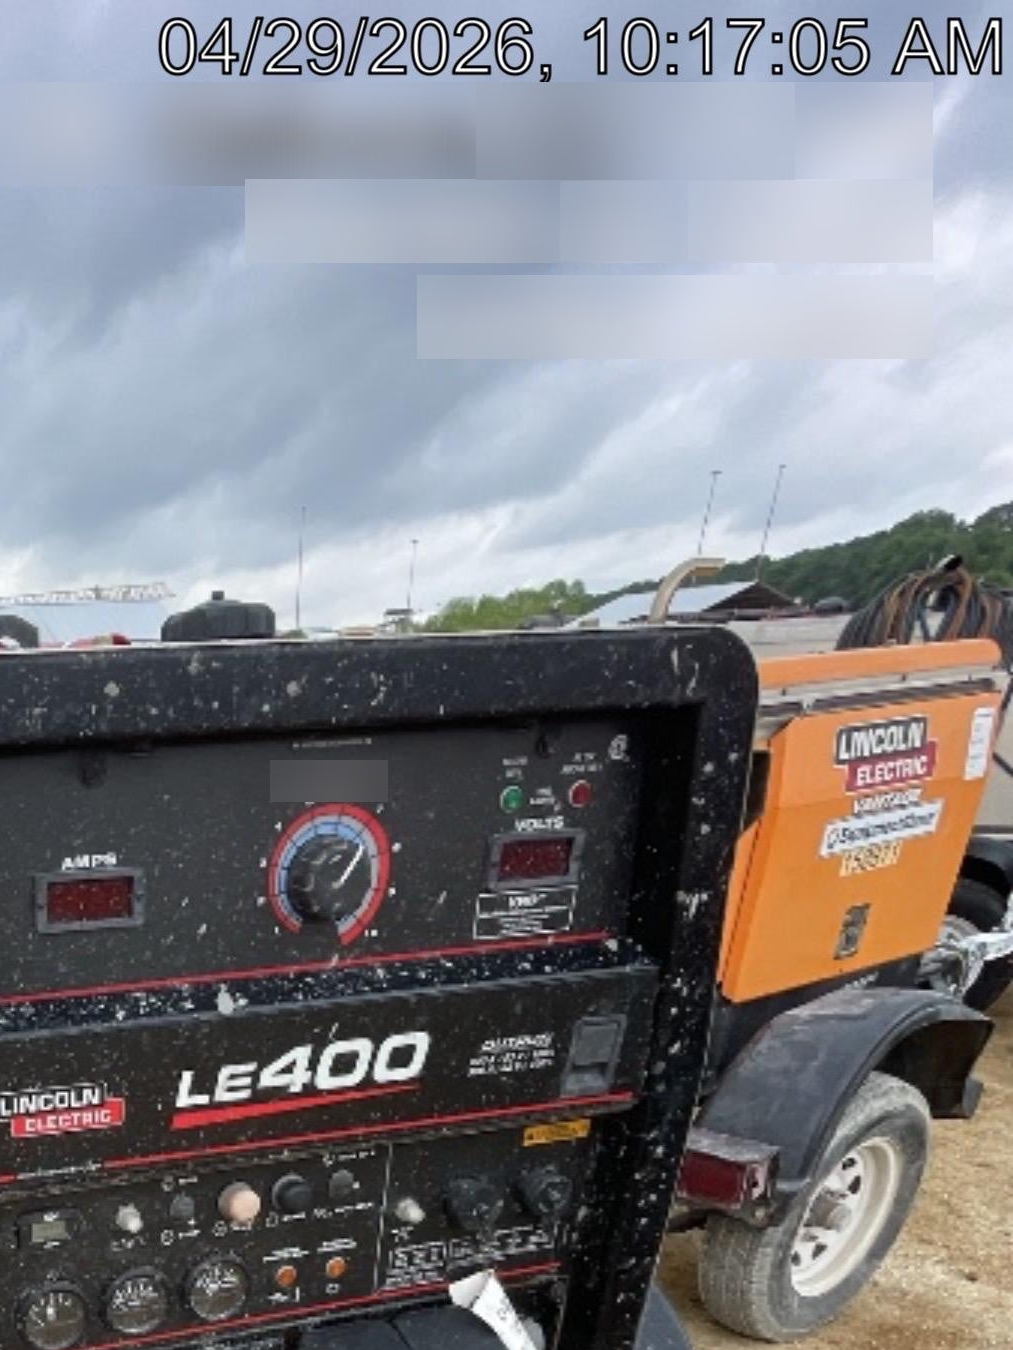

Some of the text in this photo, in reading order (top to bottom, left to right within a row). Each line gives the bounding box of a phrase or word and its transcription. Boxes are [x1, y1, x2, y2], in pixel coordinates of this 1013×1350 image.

[838, 721, 925, 761] LINCOLN
[856, 755, 928, 786] ELECTRIC
[515, 815, 564, 832] VOLTS
[61, 851, 117, 871] AMPS
[175, 1031, 430, 1108] LE400
[25, 1109, 111, 1132] ELECTRIC
